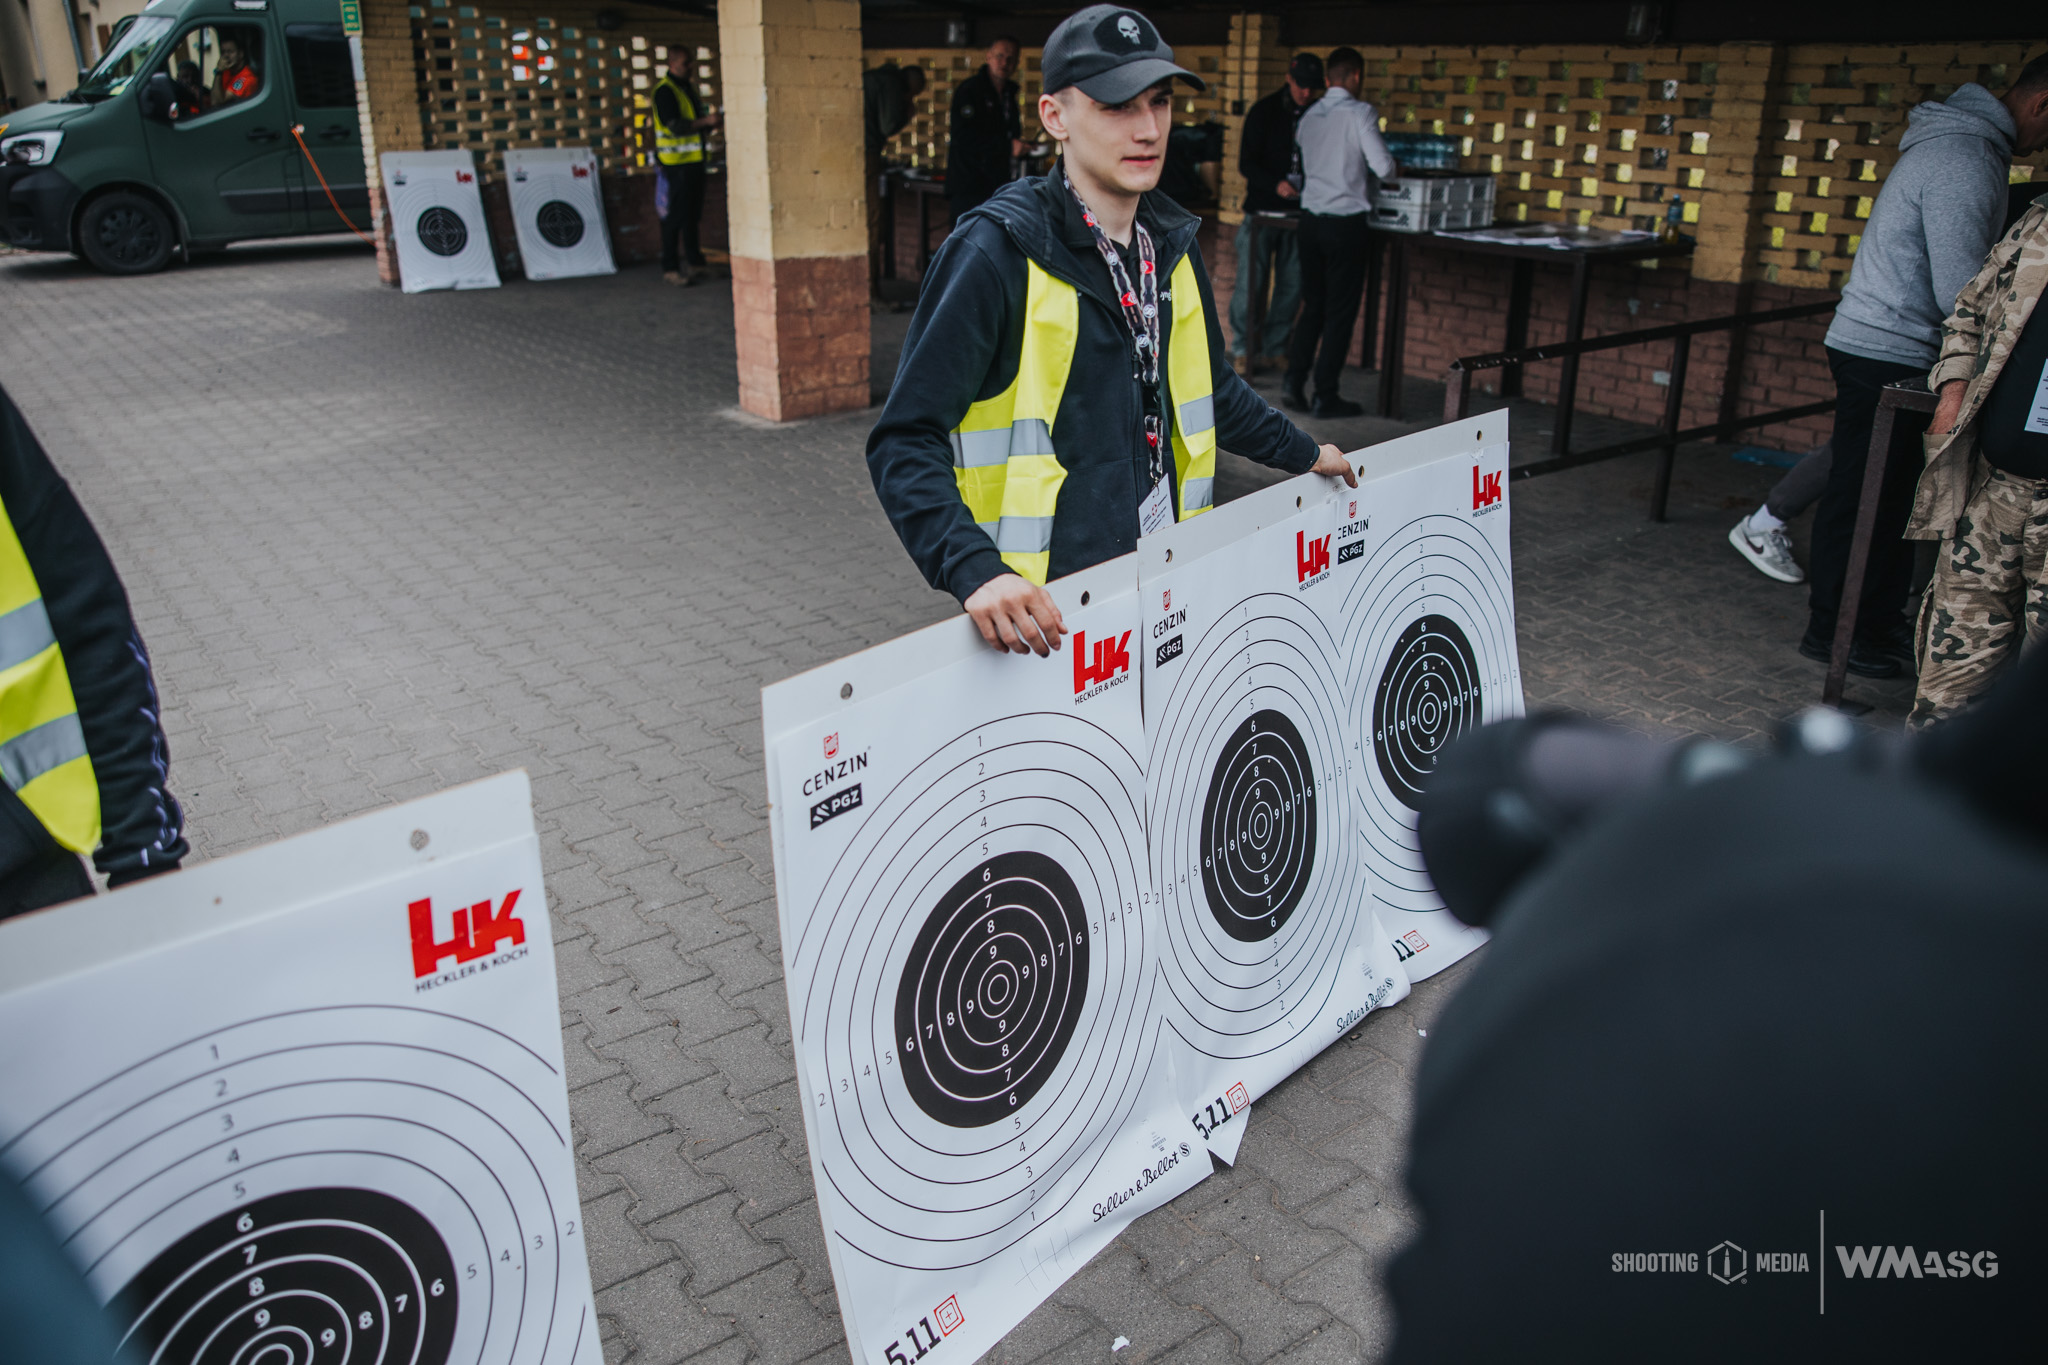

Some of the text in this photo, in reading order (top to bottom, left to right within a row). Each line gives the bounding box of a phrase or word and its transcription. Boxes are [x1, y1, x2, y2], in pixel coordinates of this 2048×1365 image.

[1153, 608, 1186, 639] CENZIN
[1166, 639, 1182, 656] PGZ
[1074, 673, 1129, 706] HECKLER & KOCH
[1250, 720, 1256, 733] 6
[977, 735, 982, 748] 1
[1252, 742, 1258, 755] 7
[803, 752, 867, 796] CENZIN
[978, 762, 985, 776] 2
[1253, 765, 1260, 778] 8
[979, 789, 986, 803] 3
[1254, 787, 1261, 800] 9
[1295, 793, 1301, 805] 7
[1306, 786, 1312, 798] 6
[831, 789, 860, 813] PGZ
[1284, 800, 1291, 812] 8
[1274, 808, 1280, 820] 9
[980, 816, 988, 829] 4
[1241, 831, 1248, 843] 9
[982, 842, 989, 856] 5
[1229, 839, 1236, 851] 8
[1217, 847, 1223, 860] 7
[1260, 852, 1267, 864] 9
[1205, 855, 1212, 868] 6
[982, 867, 991, 882] 6
[1263, 873, 1270, 885] 8
[984, 893, 992, 909] 7
[1143, 892, 1151, 905] 2
[1266, 894, 1272, 907] 7
[1126, 902, 1133, 915] 3
[1109, 911, 1116, 924] 4
[1270, 915, 1277, 928] 6
[986, 919, 996, 934] 8
[1093, 921, 1099, 935] 5
[1075, 931, 1083, 945] 6
[989, 945, 998, 960] 9
[1057, 942, 1065, 957] 7
[1040, 953, 1048, 967] 8
[415, 947, 529, 993] HECKLER & KOCH
[1022, 965, 1030, 979] 9
[966, 999, 975, 1014] 9
[946, 1011, 956, 1026] 8
[998, 1019, 1006, 1033] 9
[925, 1023, 934, 1039] 7
[905, 1036, 915, 1052] 6
[1001, 1043, 1010, 1057] 8
[210, 1044, 220, 1060] 1
[885, 1050, 893, 1065] 5
[863, 1064, 871, 1078] 4
[1004, 1067, 1012, 1082] 7
[216, 1079, 227, 1097] 2
[840, 1078, 849, 1093] 3
[818, 1092, 826, 1107] 2
[1009, 1091, 1018, 1106] 6
[222, 1114, 234, 1131] 3
[1014, 1116, 1022, 1130] 5
[1191, 1097, 1232, 1141] 5.11
[1019, 1141, 1026, 1153] 4
[228, 1148, 240, 1163] 4
[1025, 1165, 1033, 1179] 3
[234, 1182, 246, 1199] 5
[1092, 1187, 1136, 1223] Sellier
[1135, 1179, 1143, 1192] &
[1142, 1151, 1180, 1188] Bellot
[1029, 1189, 1036, 1201] 2
[237, 1213, 254, 1231] 6
[1030, 1211, 1036, 1221] 1
[566, 1220, 576, 1236] 2
[534, 1234, 544, 1250] 3
[244, 1244, 258, 1264] 7
[500, 1249, 511, 1263] 4
[466, 1263, 478, 1280] 5
[250, 1277, 265, 1296] 8
[430, 1278, 445, 1296] 6
[394, 1293, 408, 1313] 7
[254, 1309, 270, 1328] 9
[359, 1311, 373, 1329] 8
[321, 1328, 336, 1347] 9
